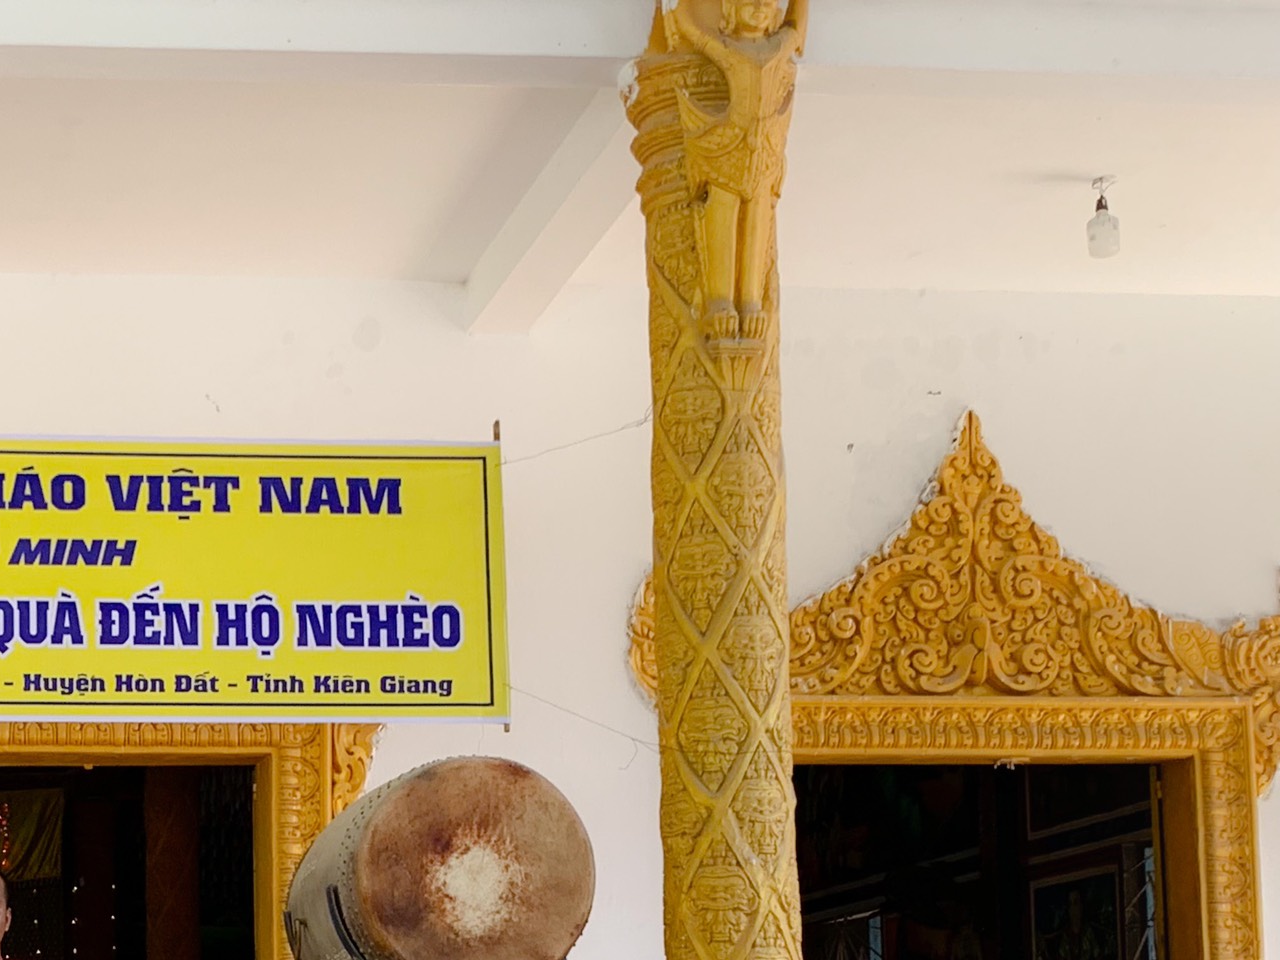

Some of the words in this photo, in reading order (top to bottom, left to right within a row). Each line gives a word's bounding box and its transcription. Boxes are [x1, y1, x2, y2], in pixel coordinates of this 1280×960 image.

[106, 469, 239, 519] VIỆT
[259, 477, 402, 514] NAM
[9, 539, 137, 565] MINH
[99, 586, 199, 645] ĐẾN
[216, 595, 279, 655] HỘ
[296, 595, 460, 647] NGHÈO
[24, 674, 105, 695] Huyện
[115, 675, 165, 692] Hòn
[175, 672, 218, 692] Đất
[247, 674, 304, 692] Tỉnh
[314, 676, 370, 693] Kiên
[381, 676, 452, 696] Giang
